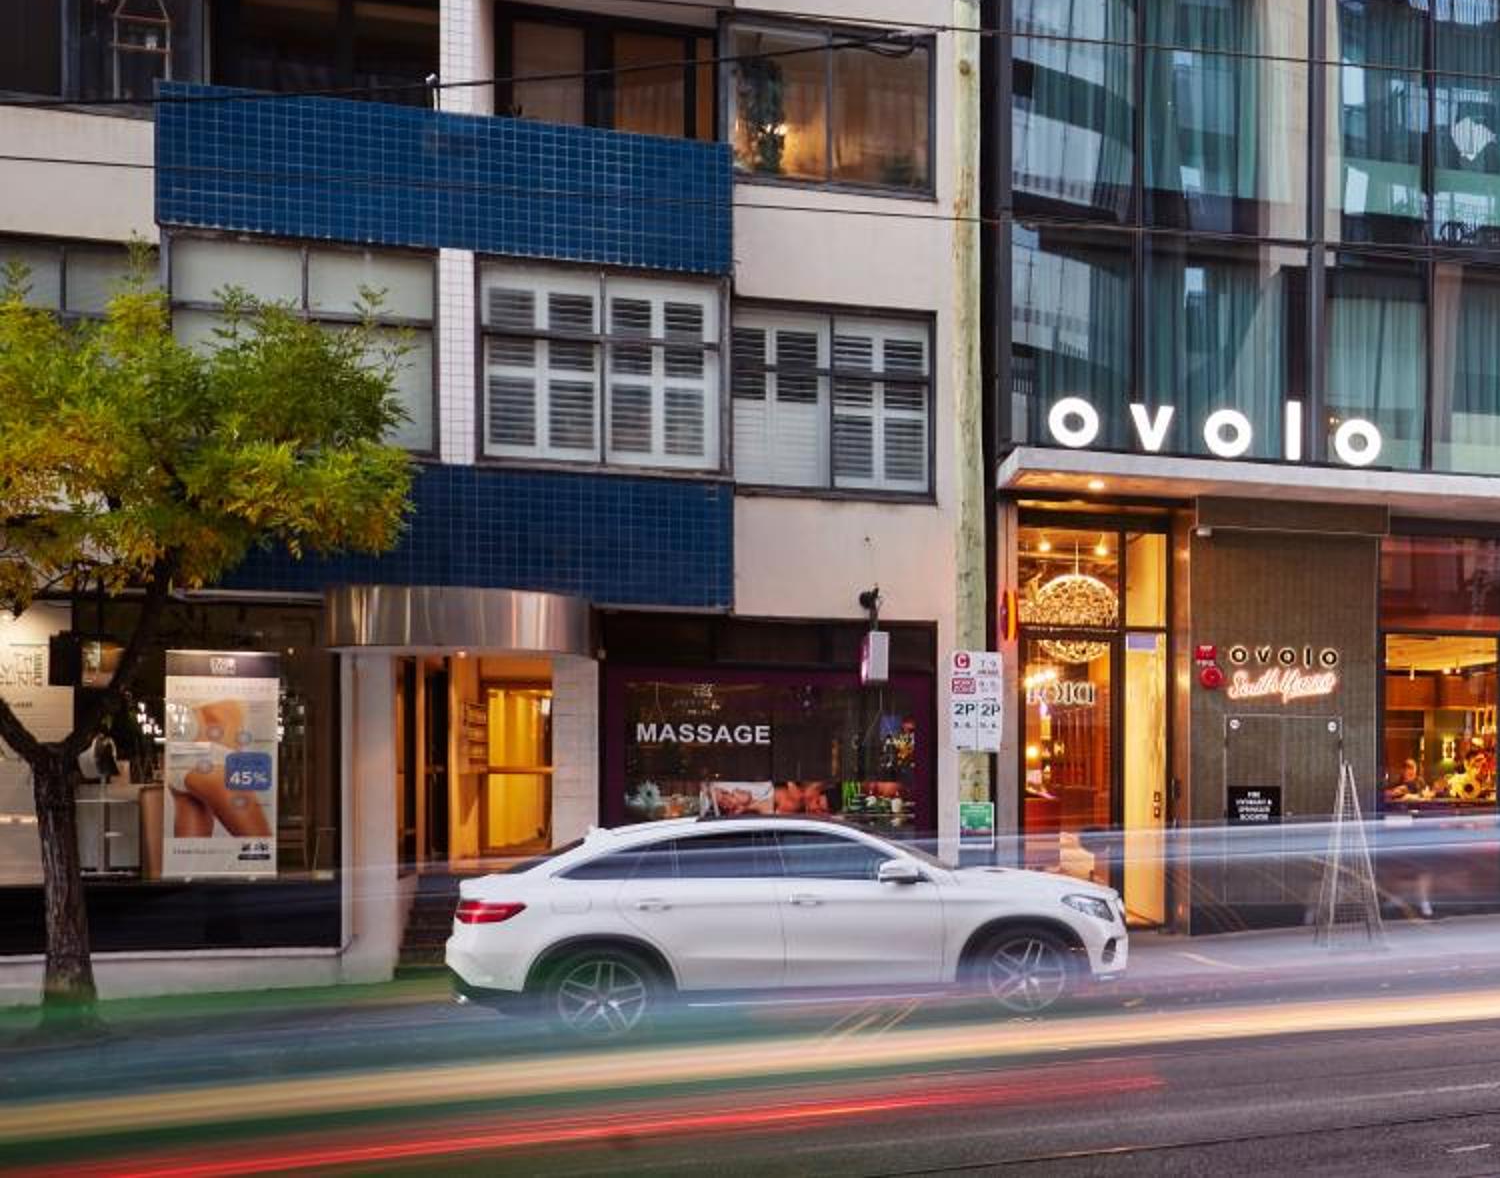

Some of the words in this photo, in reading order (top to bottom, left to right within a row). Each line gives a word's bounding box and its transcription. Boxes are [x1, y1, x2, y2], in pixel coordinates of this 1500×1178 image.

[954, 703, 976, 716] 2P
[981, 703, 1001, 717] 2P
[636, 723, 771, 744] MASSAGE
[230, 771, 268, 786] 45%
